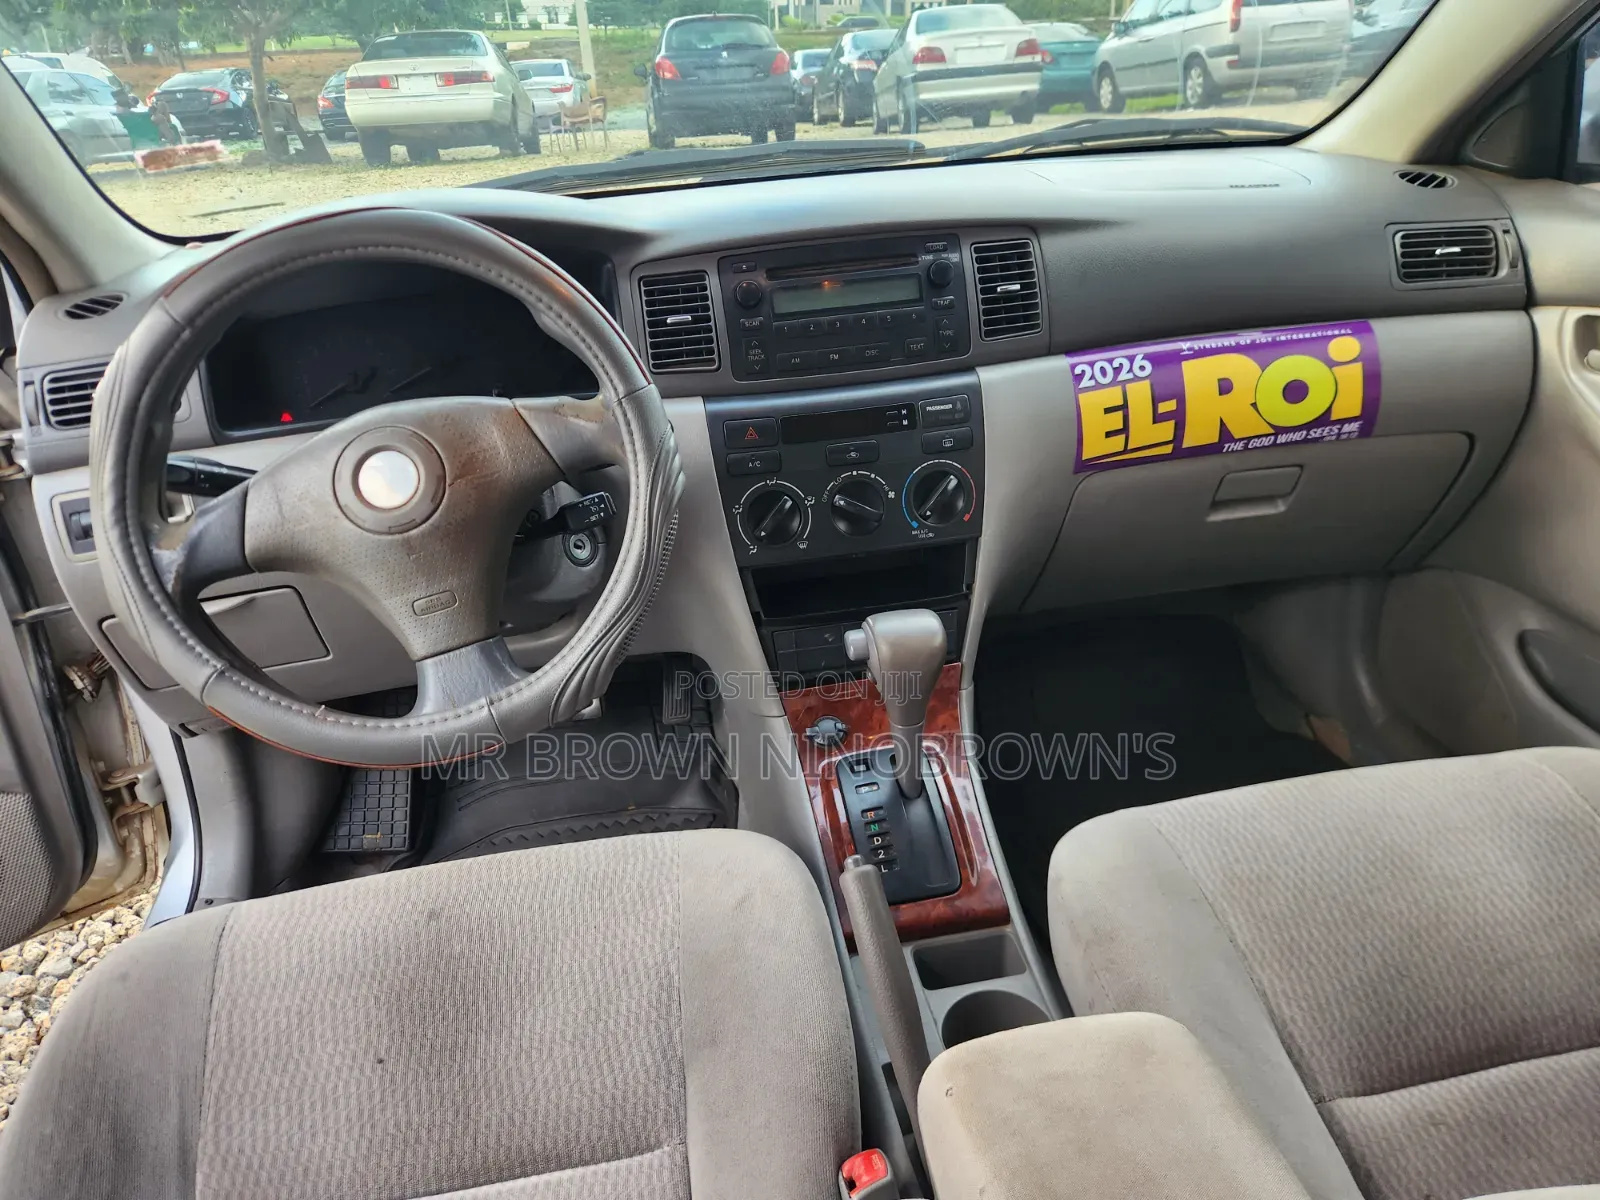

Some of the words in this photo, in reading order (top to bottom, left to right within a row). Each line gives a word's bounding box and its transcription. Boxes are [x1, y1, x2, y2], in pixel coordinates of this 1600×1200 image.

[910, 342, 925, 350] TEXT
[1074, 354, 1153, 389] 2026
[1222, 440, 1247, 453] THE
[1248, 436, 1275, 449] GOD
[1276, 430, 1307, 444] WHO
[1307, 424, 1341, 439] SEES
[1340, 420, 1364, 433] ME
[748, 460, 761, 468] A/C
[833, 476, 843, 485] LO
[882, 484, 890, 492] HI
[821, 490, 830, 503] OFF
[867, 811, 875, 819] R
[871, 823, 879, 832] N
[873, 836, 882, 845] D
[877, 849, 885, 859] 2
[881, 864, 888, 873] L
